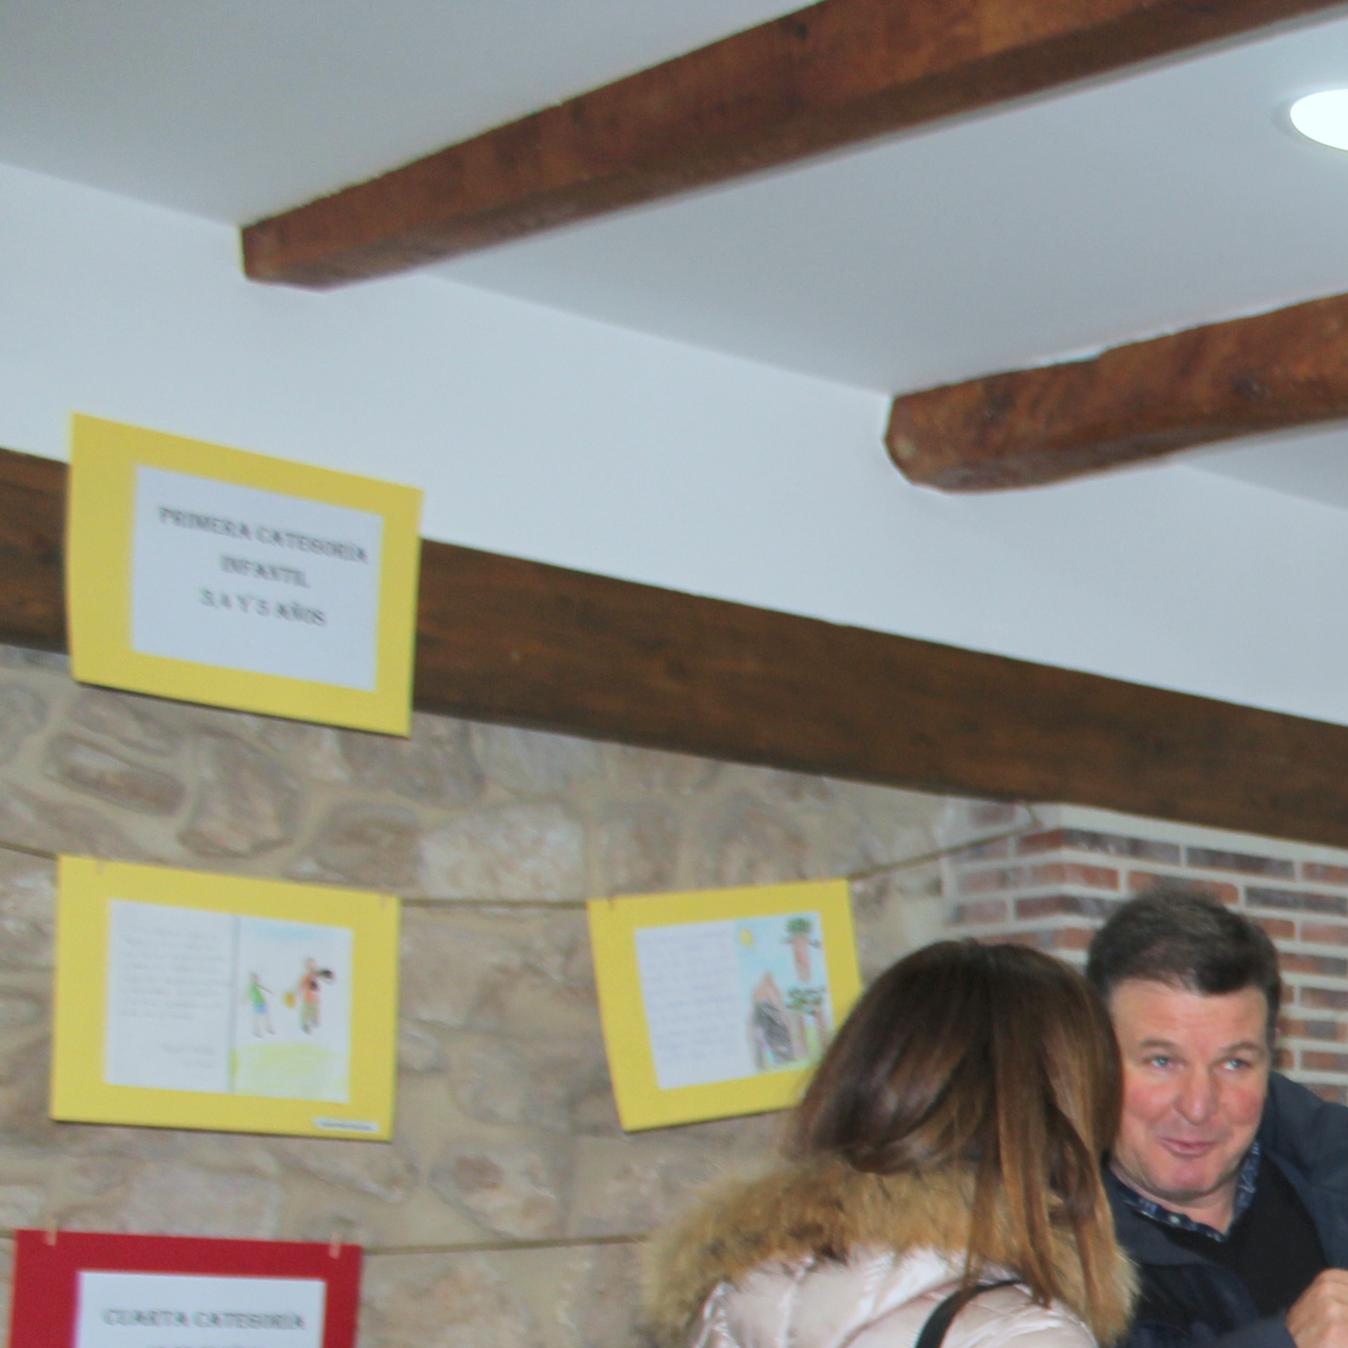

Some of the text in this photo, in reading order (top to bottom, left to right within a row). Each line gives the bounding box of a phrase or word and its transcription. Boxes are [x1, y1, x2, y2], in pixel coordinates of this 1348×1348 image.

[158, 505, 252, 541] PRIMERA
[219, 554, 311, 589] INFANTIL
[274, 601, 329, 627] AÑOS
[101, 1308, 189, 1328] CUARTA
